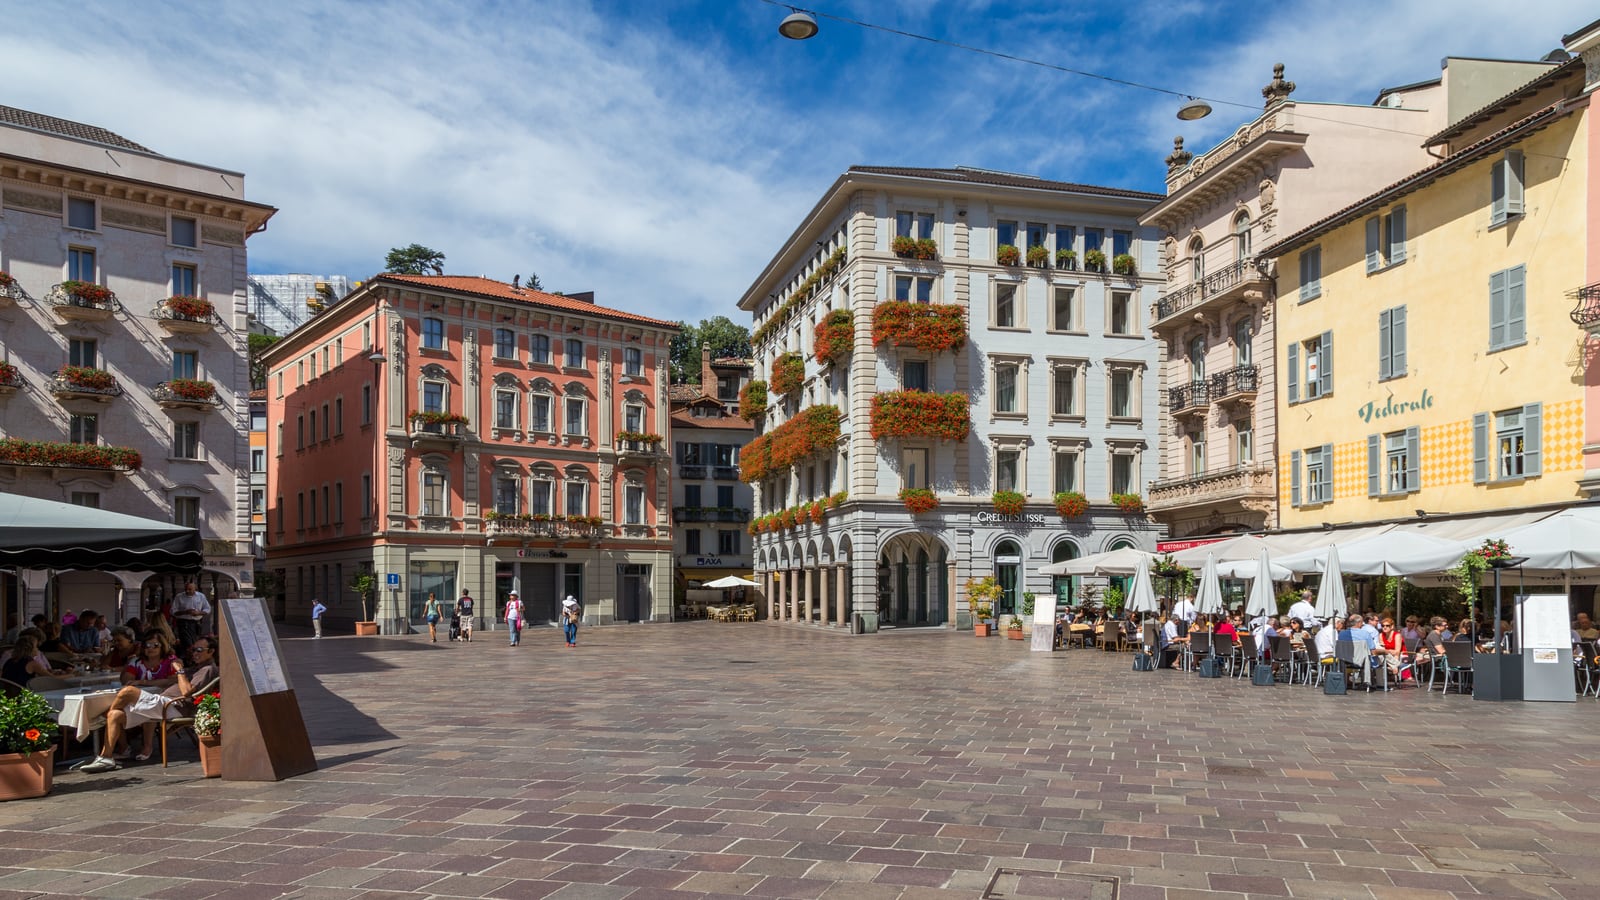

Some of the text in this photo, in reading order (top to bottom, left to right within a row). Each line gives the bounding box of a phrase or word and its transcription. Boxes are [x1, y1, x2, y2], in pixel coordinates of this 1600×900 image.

[1358, 388, 1433, 423] Federale
[977, 511, 1045, 523] CREDIT SUISSE
[1162, 542, 1191, 550] RISTORANTE
